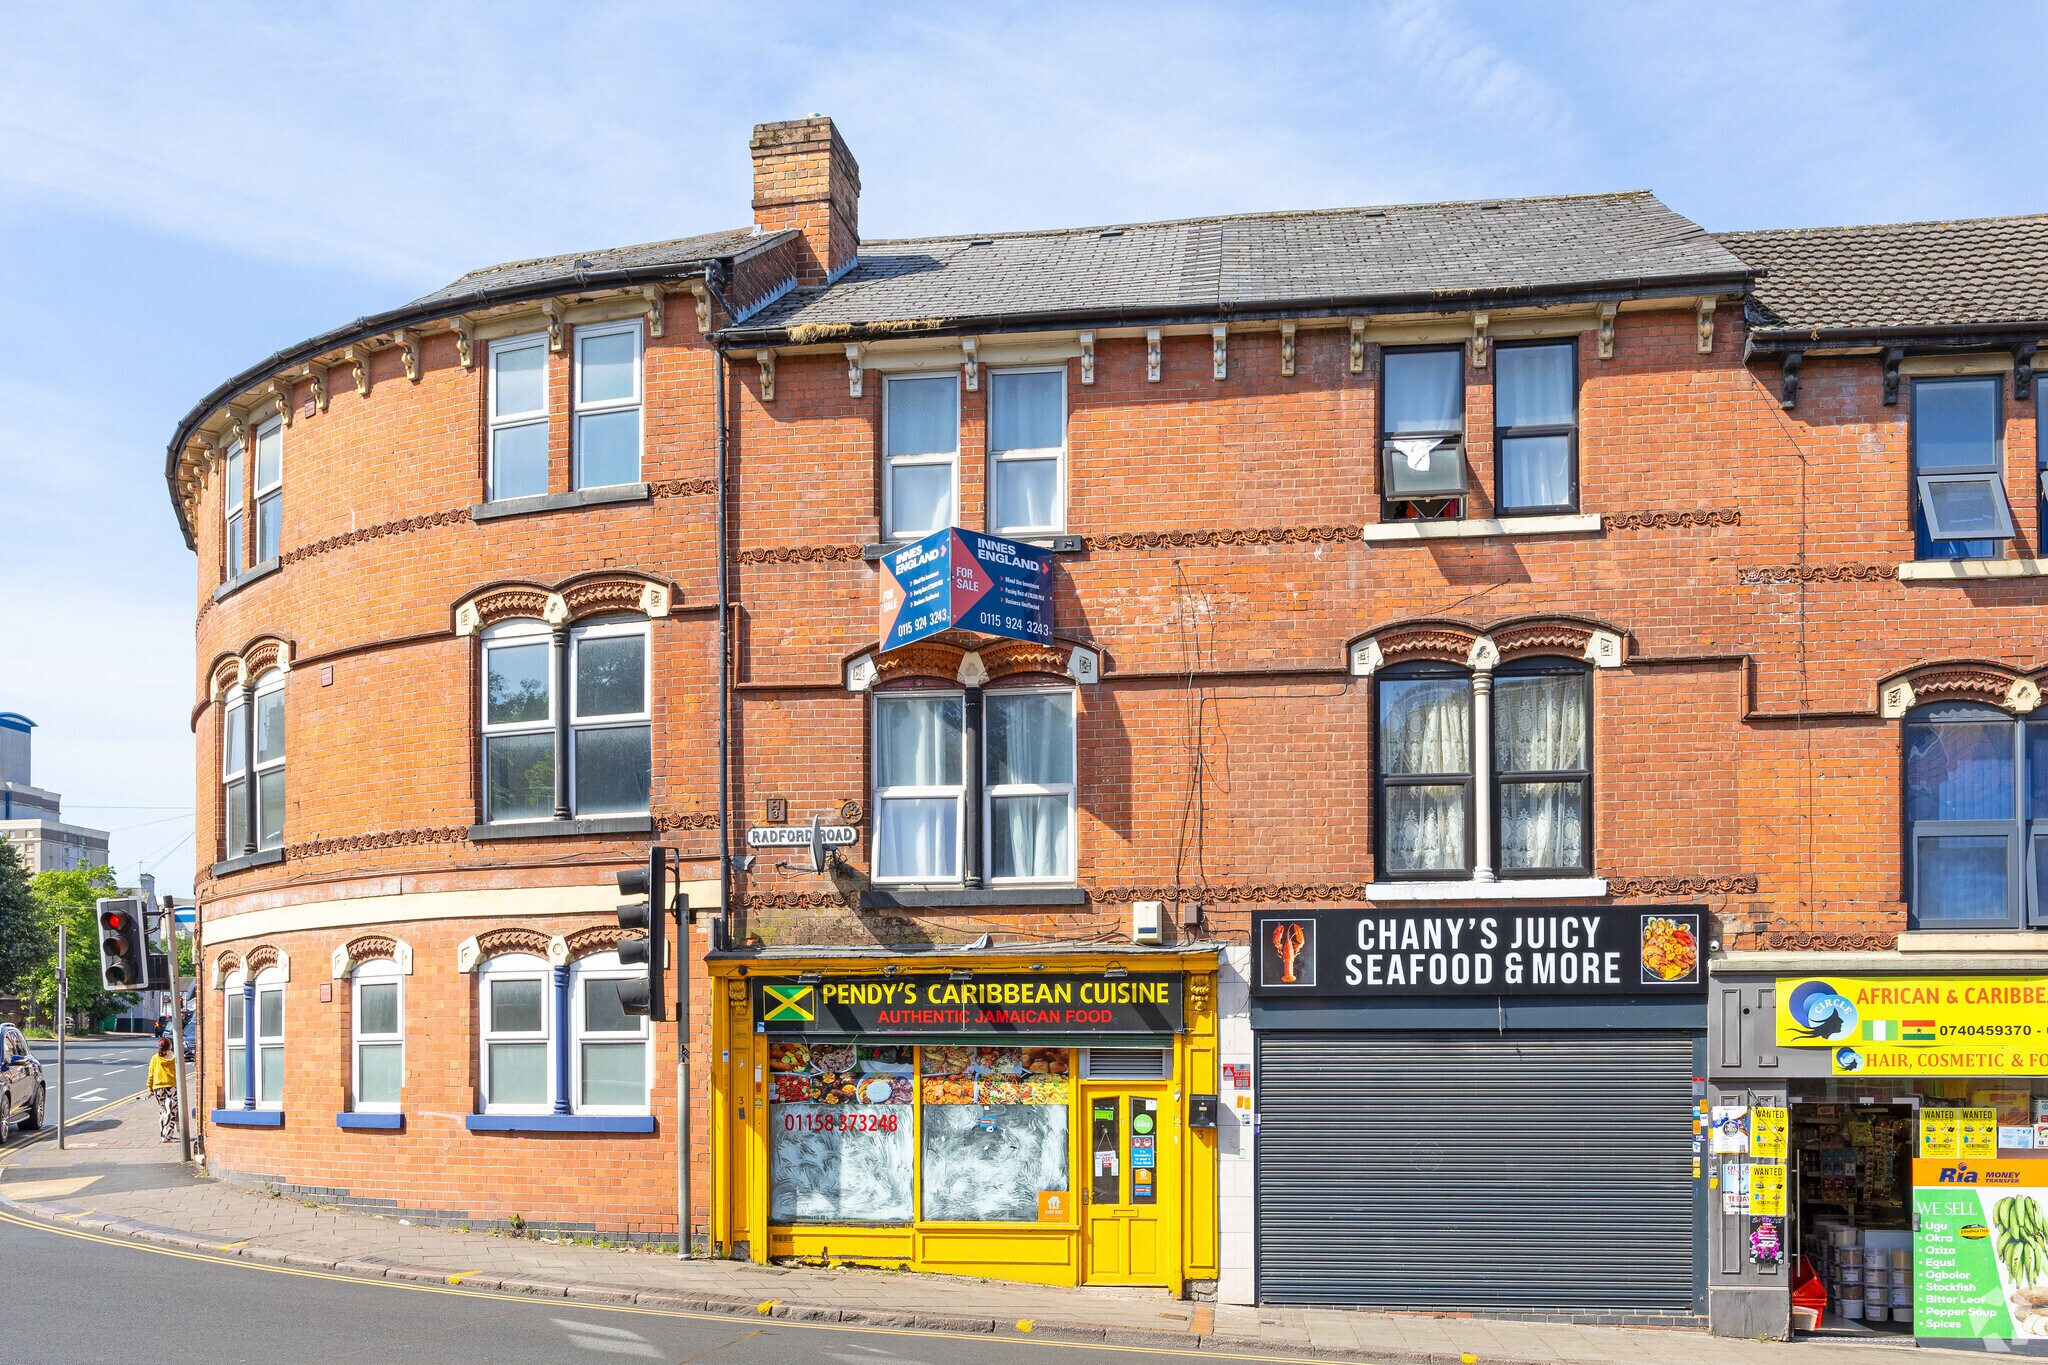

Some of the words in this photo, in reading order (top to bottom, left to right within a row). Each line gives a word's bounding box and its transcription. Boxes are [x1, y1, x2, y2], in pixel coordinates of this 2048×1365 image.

[978, 537, 1016, 555] INNES
[895, 548, 940, 576] ENGLAND
[896, 545, 923, 565] INNES
[978, 549, 1039, 572] ENGLAND
[956, 566, 973, 579] FOR
[956, 578, 979, 592] SALE
[883, 588, 894, 601] FOR
[883, 598, 898, 612] SALE
[898, 621, 913, 637] 0115
[914, 615, 927, 632] 924
[929, 608, 947, 626] 3243
[980, 611, 1001, 627] 0115
[1005, 616, 1023, 631] 924
[1026, 620, 1049, 636] 3243
[752, 829, 811, 844] RADFORD
[820, 828, 853, 842] ROAD
[1357, 916, 1498, 951] CHANY'S
[1510, 916, 1601, 950] JUICY
[1345, 952, 1493, 986] SEAFOOD
[1505, 952, 1524, 985] &
[1532, 951, 1621, 985] MORE
[822, 982, 917, 1005] PENDY'S
[927, 982, 1072, 1005] CARIBBEAN
[1079, 982, 1169, 1005] CUISINE
[1856, 987, 1940, 1005] AFRICAN
[1946, 989, 1959, 1004] &
[1964, 987, 2048, 1004] CARIBBE
[1813, 997, 1853, 1015] CIRCLE
[877, 1009, 971, 1024] AUTHENTIC
[975, 1009, 1060, 1024] JAMAICAN
[1065, 1009, 1113, 1023] FOOD
[1939, 1025, 2032, 1036] 0740459370
[1866, 1053, 1913, 1070] HAIR,
[1917, 1052, 2005, 1068] COSMETIC
[2011, 1053, 2024, 1068] &
[738, 1096, 744, 1105] 3
[1755, 1110, 1785, 1119] WANTED
[1924, 1110, 1954, 1119] WANTED
[1962, 1110, 1993, 1119] WANTED
[784, 1114, 834, 1132] 01158
[838, 1114, 898, 1132] 373248
[1197, 1129, 1204, 1139] 3
[1754, 1167, 1783, 1176] WANTED
[1939, 1162, 1979, 1183] Ria
[1917, 1201, 1941, 1216] WE
[1944, 1201, 1978, 1216] SELL
[1925, 1221, 1948, 1233] Ugu
[1925, 1233, 1953, 1243] Okra
[1925, 1245, 1956, 1255] Oziza
[1925, 1258, 1955, 1269] Egusi
[1925, 1270, 1971, 1281] Ogbolor
[1925, 1282, 1976, 1292] Stockfish
[1925, 1294, 1958, 1304] Bitter
[1960, 1294, 1986, 1304] Leaf
[1925, 1306, 1966, 1317] Pepper
[1968, 1306, 1997, 1318] Soup
[1925, 1319, 1961, 1330] Spices
